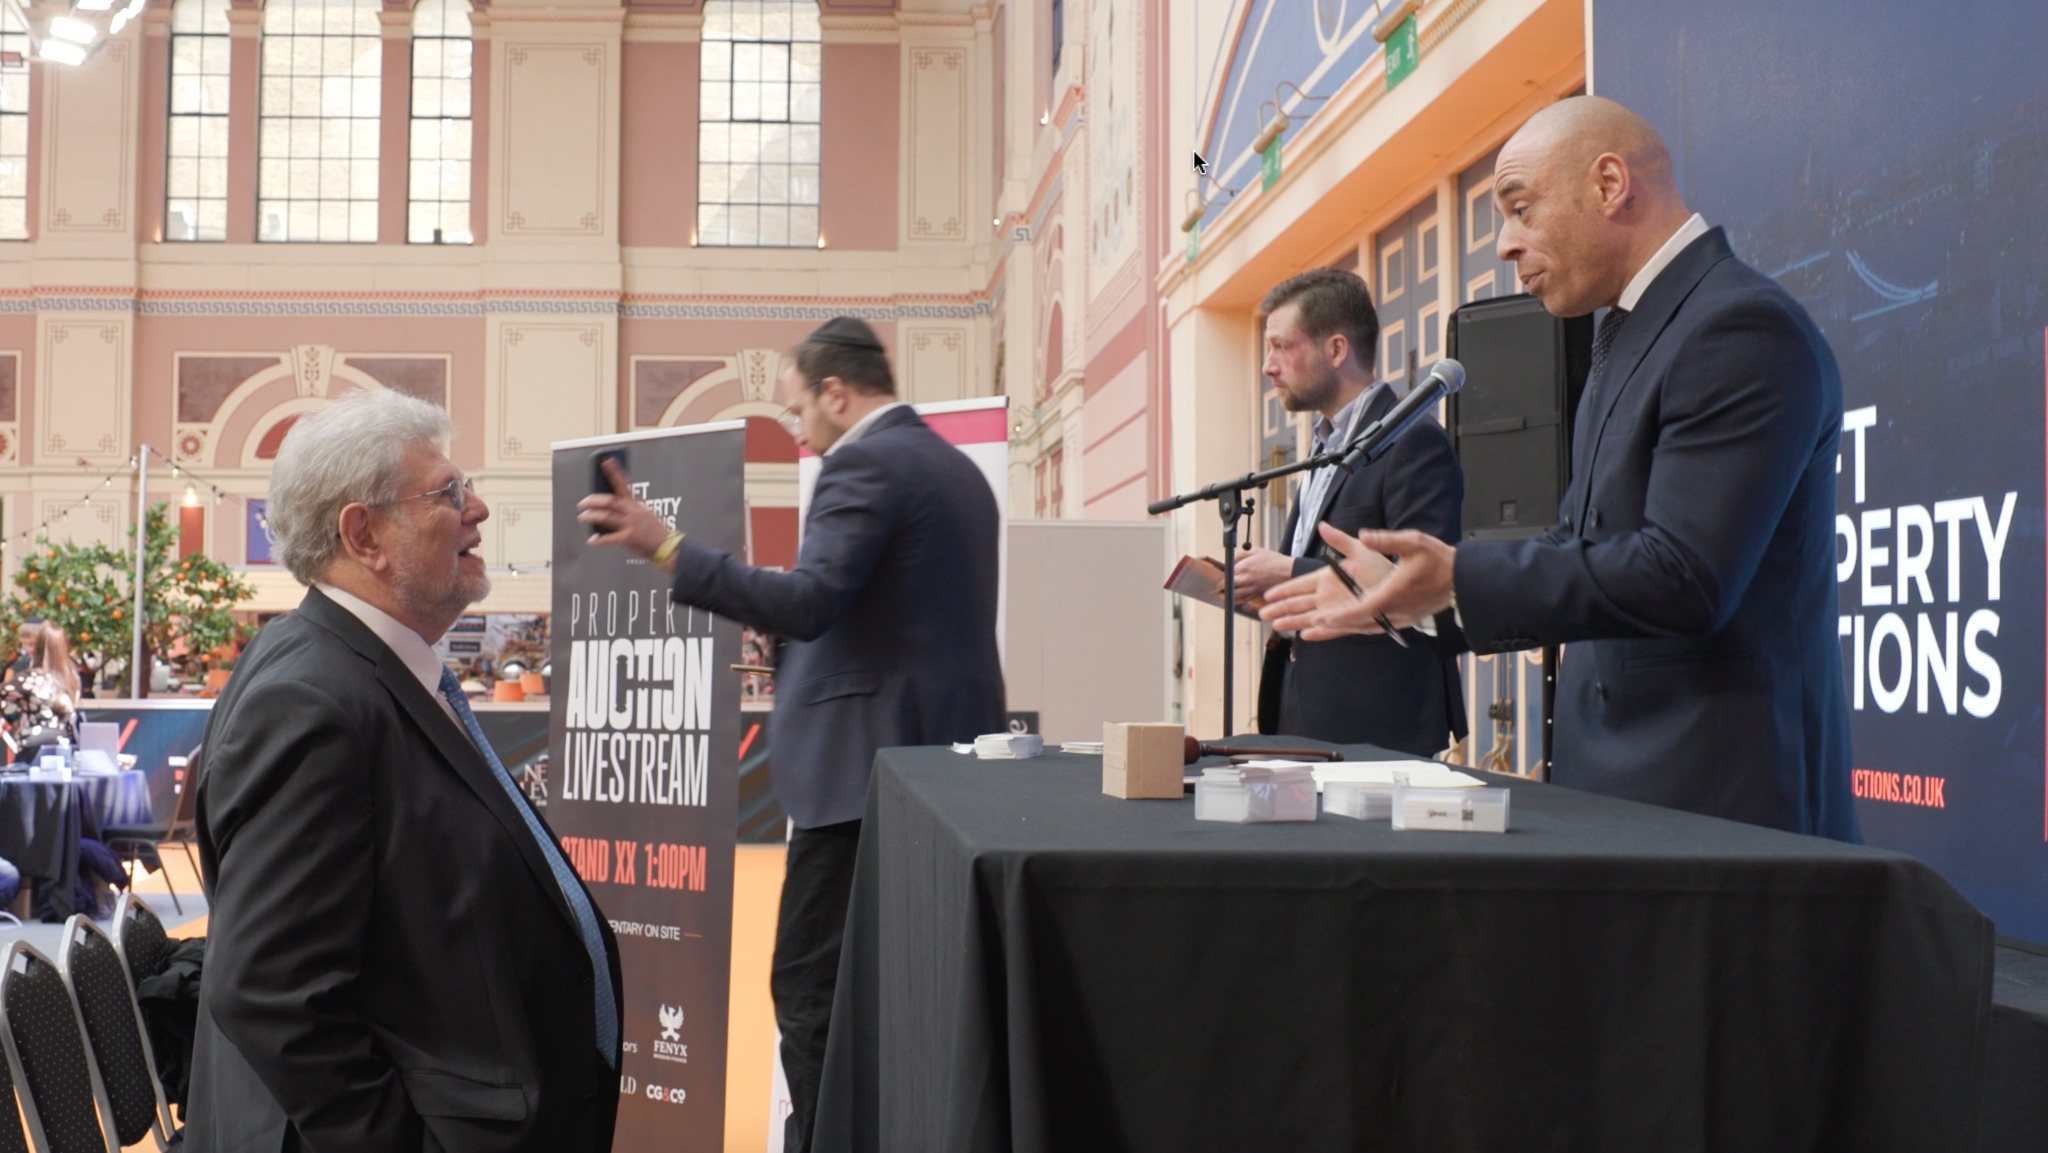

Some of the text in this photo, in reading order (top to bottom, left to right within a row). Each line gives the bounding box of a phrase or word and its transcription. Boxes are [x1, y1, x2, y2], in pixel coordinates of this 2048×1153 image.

[566, 636, 714, 731] AUCTION
[562, 731, 709, 807] LIVESTREAM
[614, 839, 637, 885] XX
[644, 842, 706, 892] 1:00PM
[644, 923, 659, 938] ON
[660, 925, 680, 941] SITE
[653, 1040, 688, 1057] FENYX
